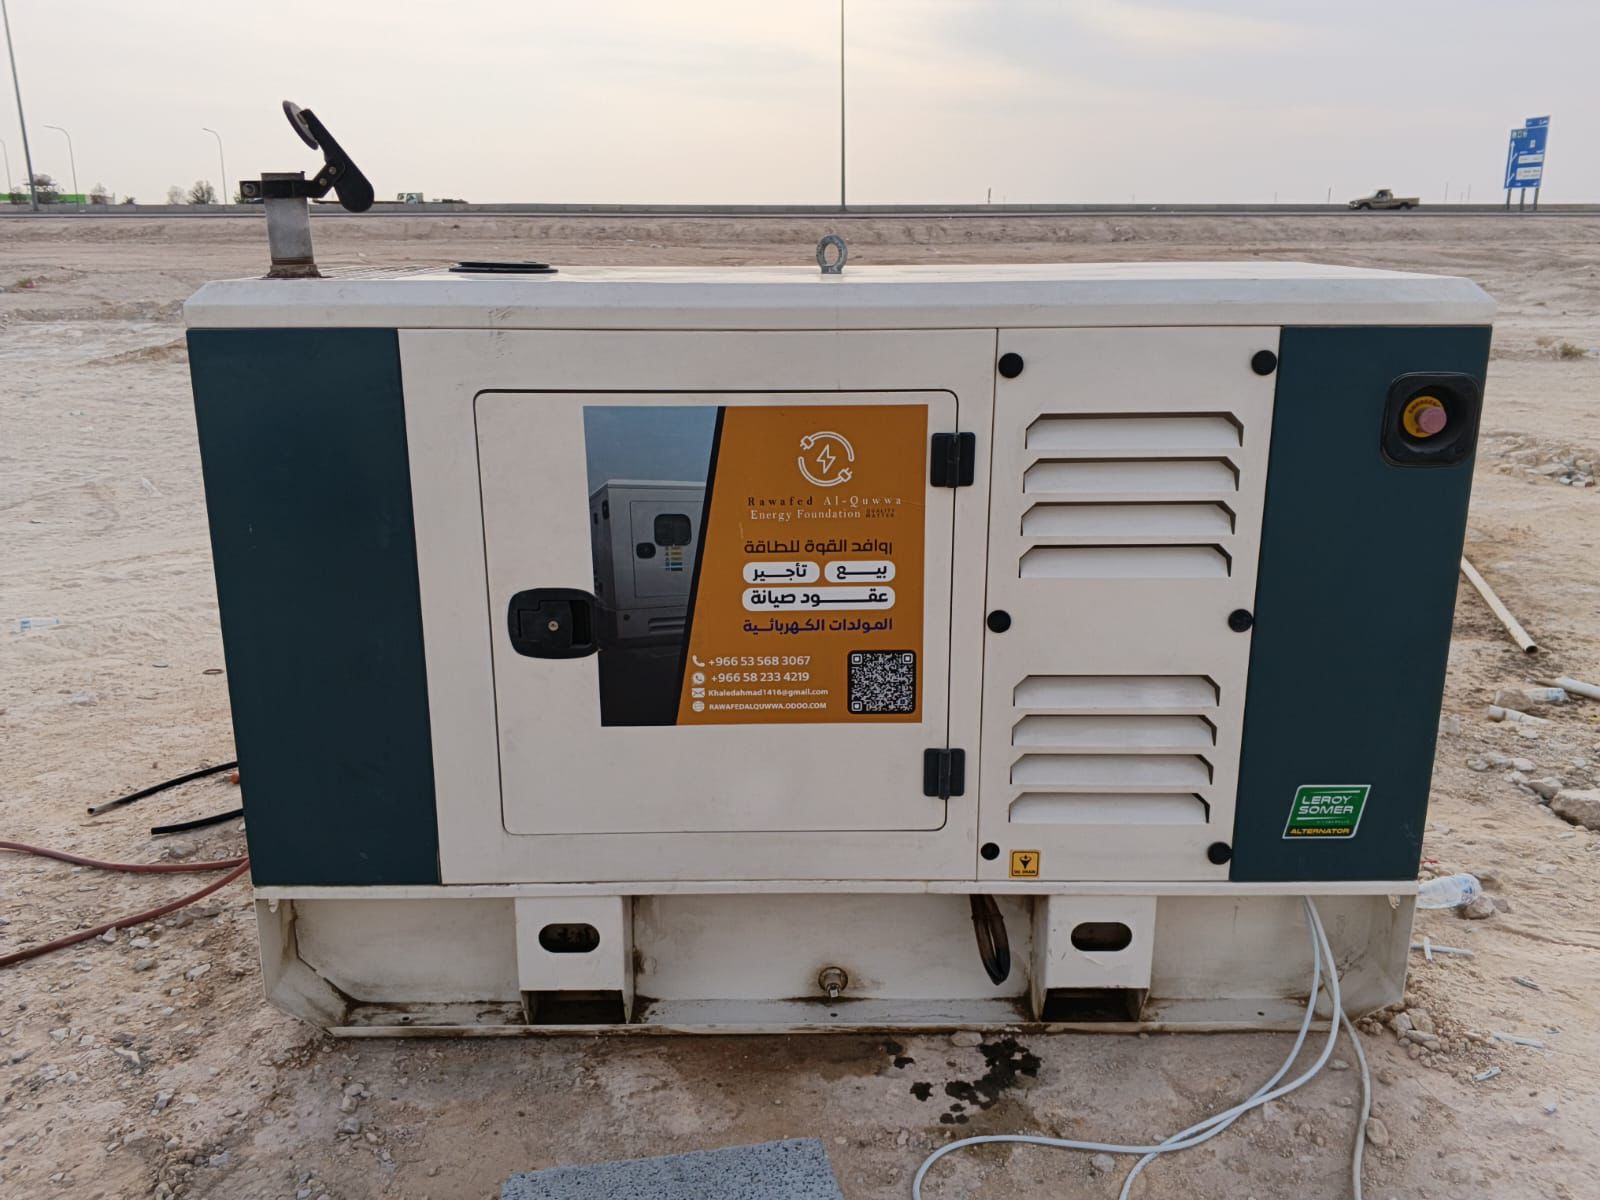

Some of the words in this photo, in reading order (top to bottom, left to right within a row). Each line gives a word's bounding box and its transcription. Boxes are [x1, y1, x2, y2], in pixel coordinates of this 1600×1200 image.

[748, 496, 813, 507] Rawafed
[823, 495, 902, 508] Al-Quwwa
[751, 510, 791, 522] Energy
[797, 508, 861, 519] Foundation
[744, 539, 800, 554] للطاقة
[804, 539, 847, 555] القوة
[851, 539, 892, 555] روافد
[750, 589, 796, 608] صيانة
[829, 618, 893, 634] المولدات
[708, 656, 739, 667] +966
[740, 656, 754, 666] 53
[756, 655, 780, 666] 568
[781, 655, 811, 666] 3067
[711, 672, 741, 683] +966
[743, 672, 758, 682] 58
[760, 672, 781, 682] 233
[783, 671, 810, 682] 4219
[1302, 796, 1352, 805] LEROY
[1298, 806, 1354, 815] SOMER
